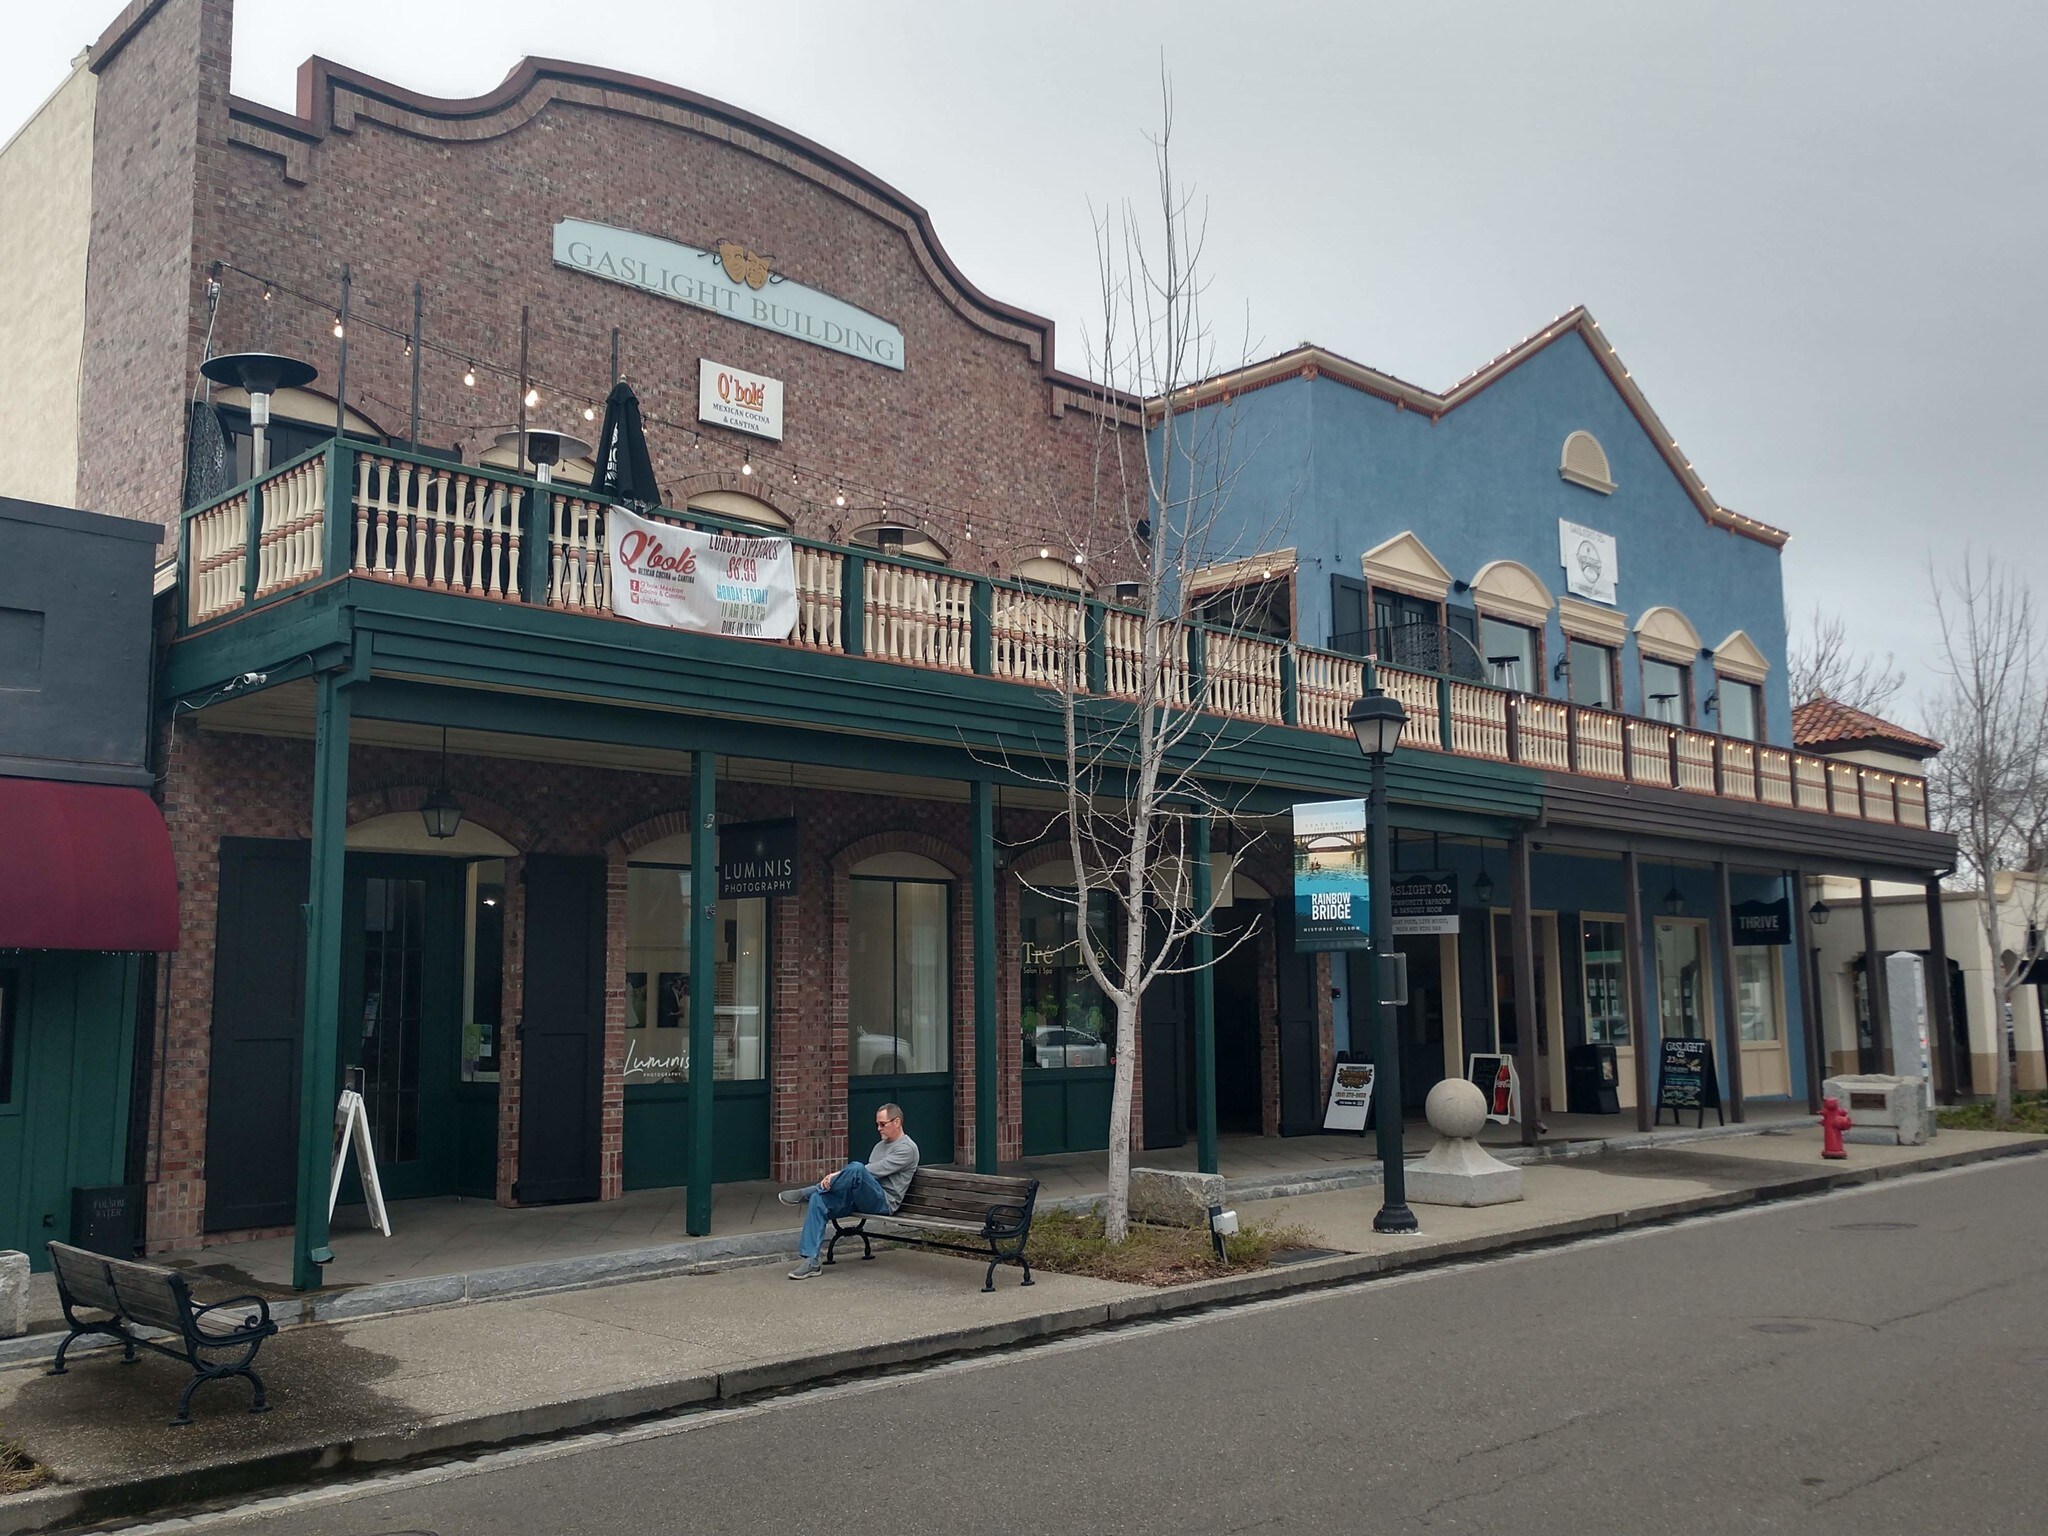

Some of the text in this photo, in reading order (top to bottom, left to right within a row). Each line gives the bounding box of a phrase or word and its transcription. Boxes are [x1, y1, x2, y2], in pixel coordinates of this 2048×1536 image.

[567, 241, 895, 361] GASLIGHT BUILDING
[712, 403, 771, 424] MEXICAN COCINA
[730, 418, 760, 431] CANTINA
[619, 530, 697, 575] Q'bolé
[709, 534, 781, 560] LUNCH SPECIALS
[726, 556, 757, 582] $6.99
[728, 603, 739, 618] AM
[741, 604, 749, 620] TO
[750, 605, 755, 620] 3
[756, 606, 766, 621] PM
[721, 620, 736, 634] DINE
[736, 621, 744, 635] IN
[725, 859, 791, 880] LUMINIS
[725, 881, 791, 893] PHOTOGRAPHY
[1390, 884, 1452, 896] ASLIGHT CO.
[1312, 892, 1351, 906] RAINBOW
[1312, 904, 1351, 920] BRIDGE
[1739, 915, 1779, 930] THRIVE
[1023, 966, 1053, 975] Salon Spa
[1665, 1041, 1705, 1053] GASLIGHT
[623, 1039, 690, 1077] Luminis
